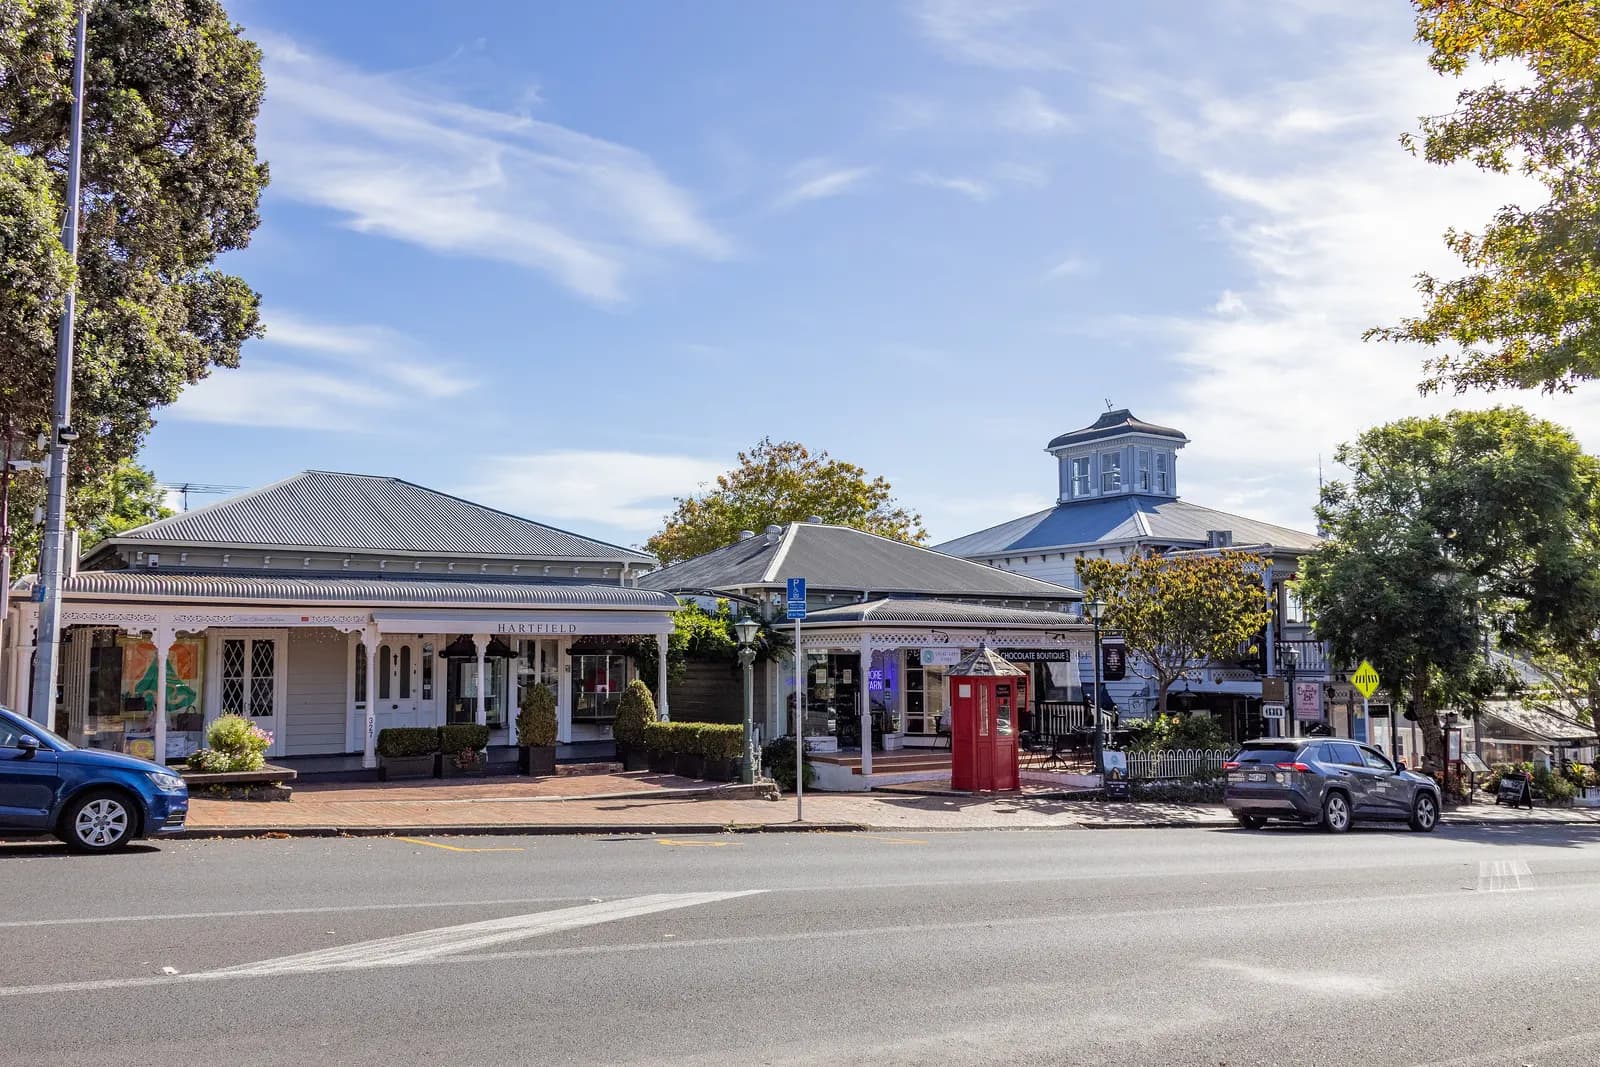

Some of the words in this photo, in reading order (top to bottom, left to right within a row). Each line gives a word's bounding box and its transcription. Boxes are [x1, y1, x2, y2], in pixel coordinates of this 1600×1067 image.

[498, 623, 577, 633] HARTFIELD
[1000, 652, 1036, 660] CHOCOLATE
[1036, 652, 1065, 660] BOUTIQUE
[868, 670, 882, 680] ORE
[869, 680, 882, 690] ARN
